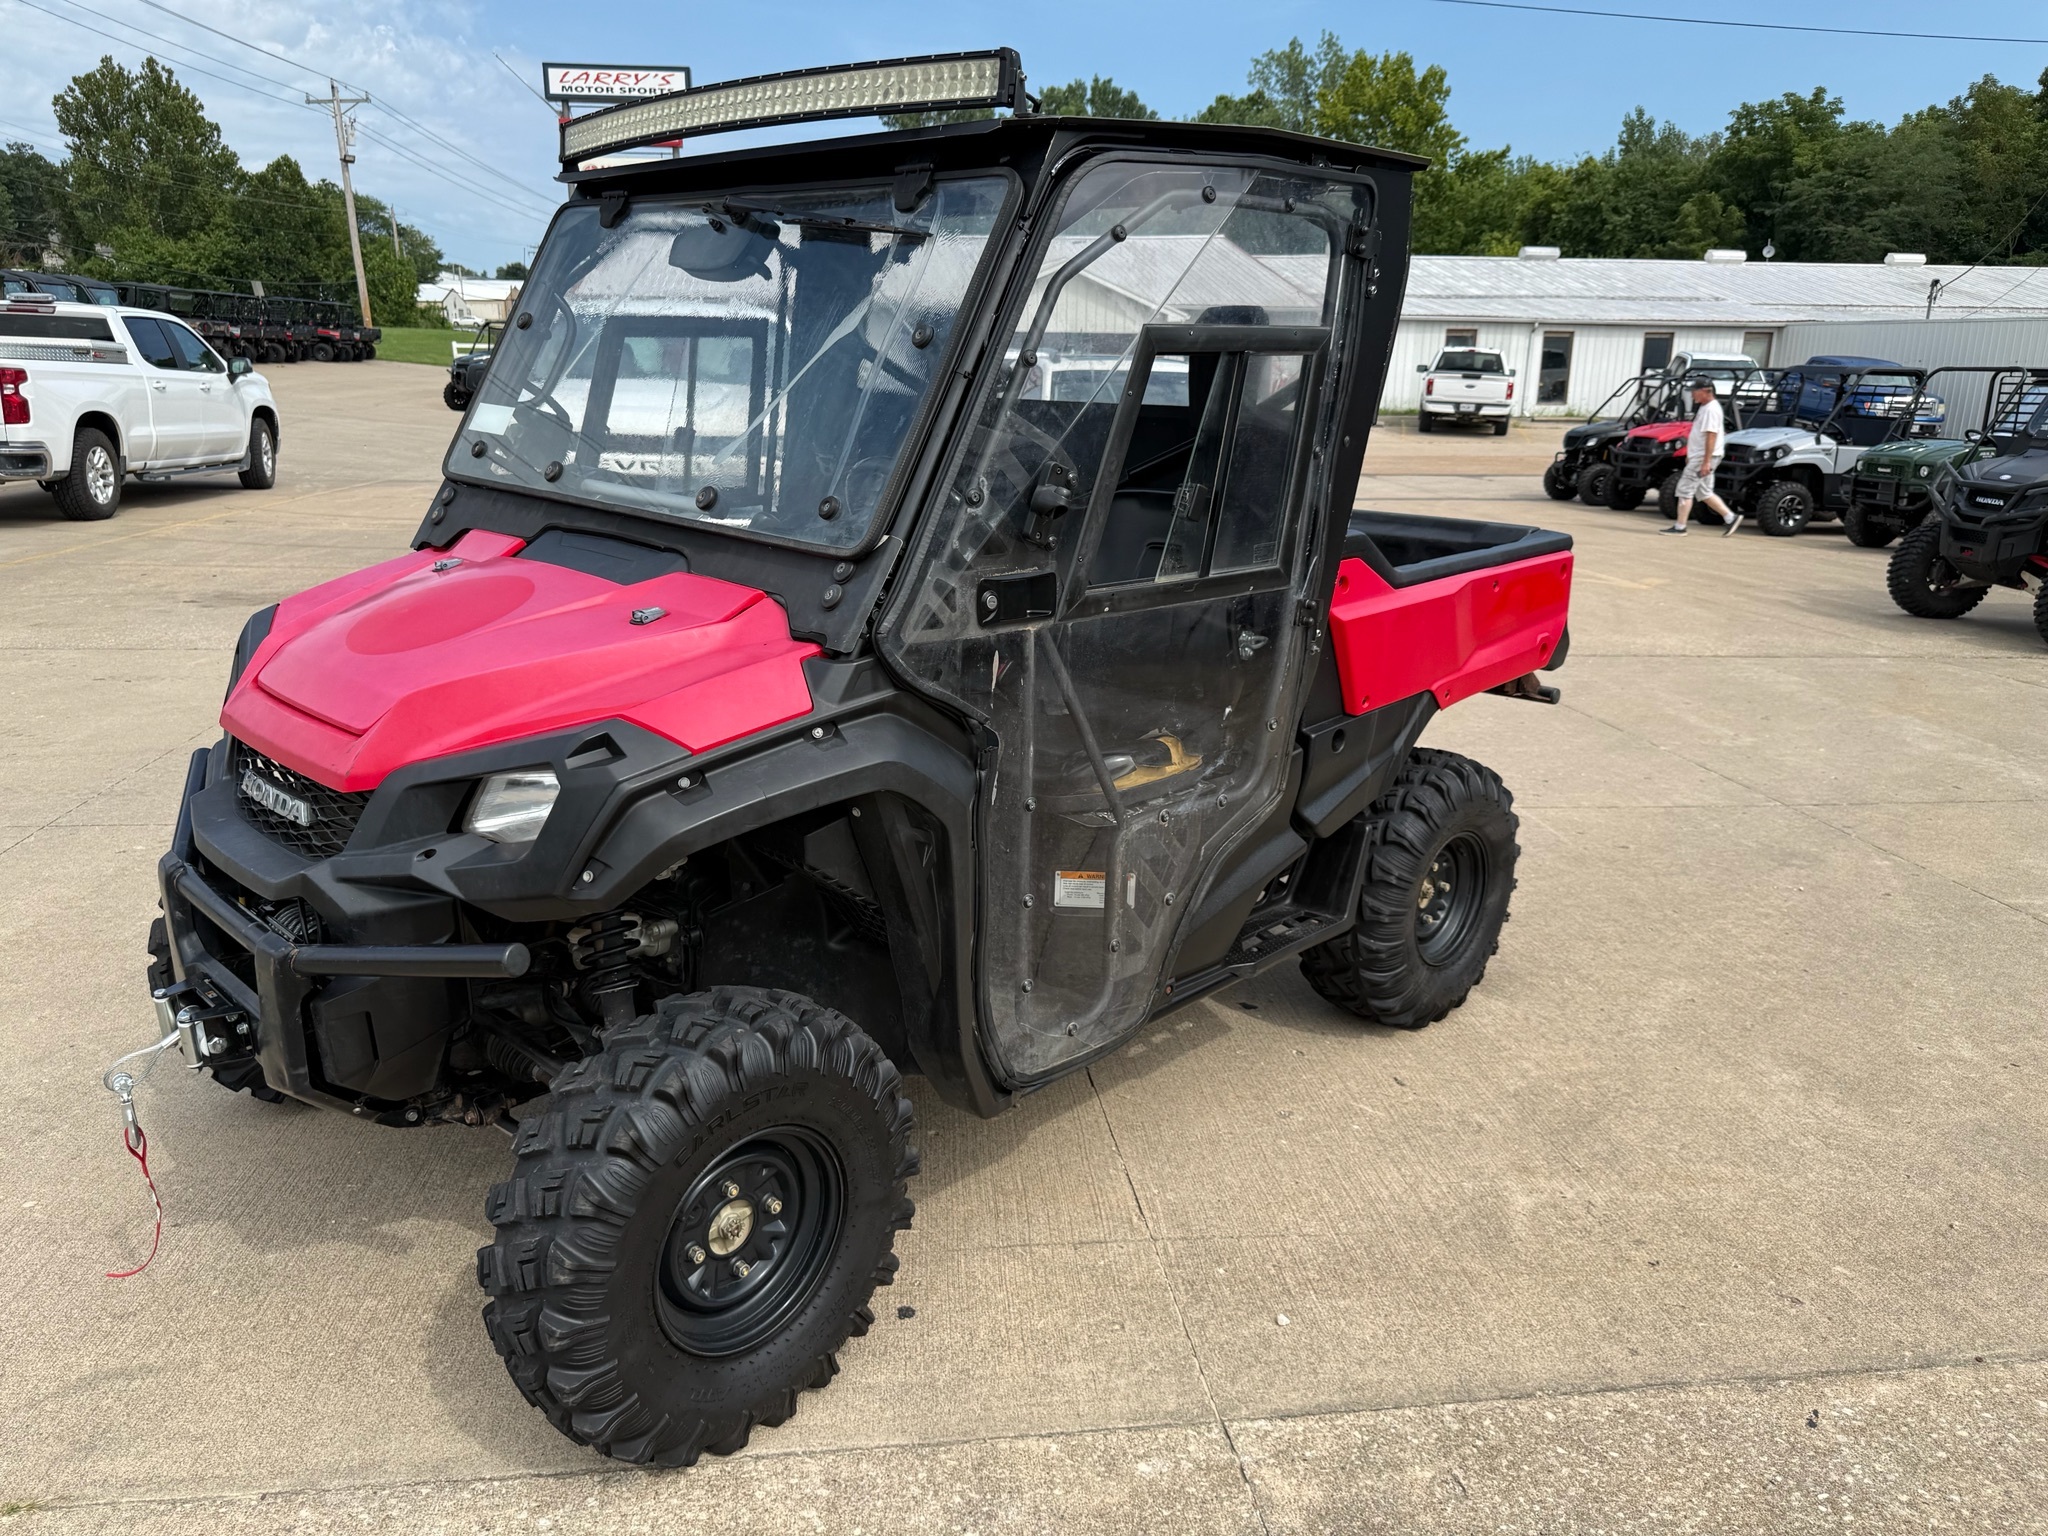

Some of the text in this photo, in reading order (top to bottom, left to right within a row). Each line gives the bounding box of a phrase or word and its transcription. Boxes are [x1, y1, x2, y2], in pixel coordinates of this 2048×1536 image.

[559, 70, 675, 86] LARRY'S
[561, 85, 614, 94] MOTOR
[1975, 496, 2004, 506] HONDA
[241, 768, 311, 827] HONDA
[673, 1081, 809, 1168] CARLSTAR
